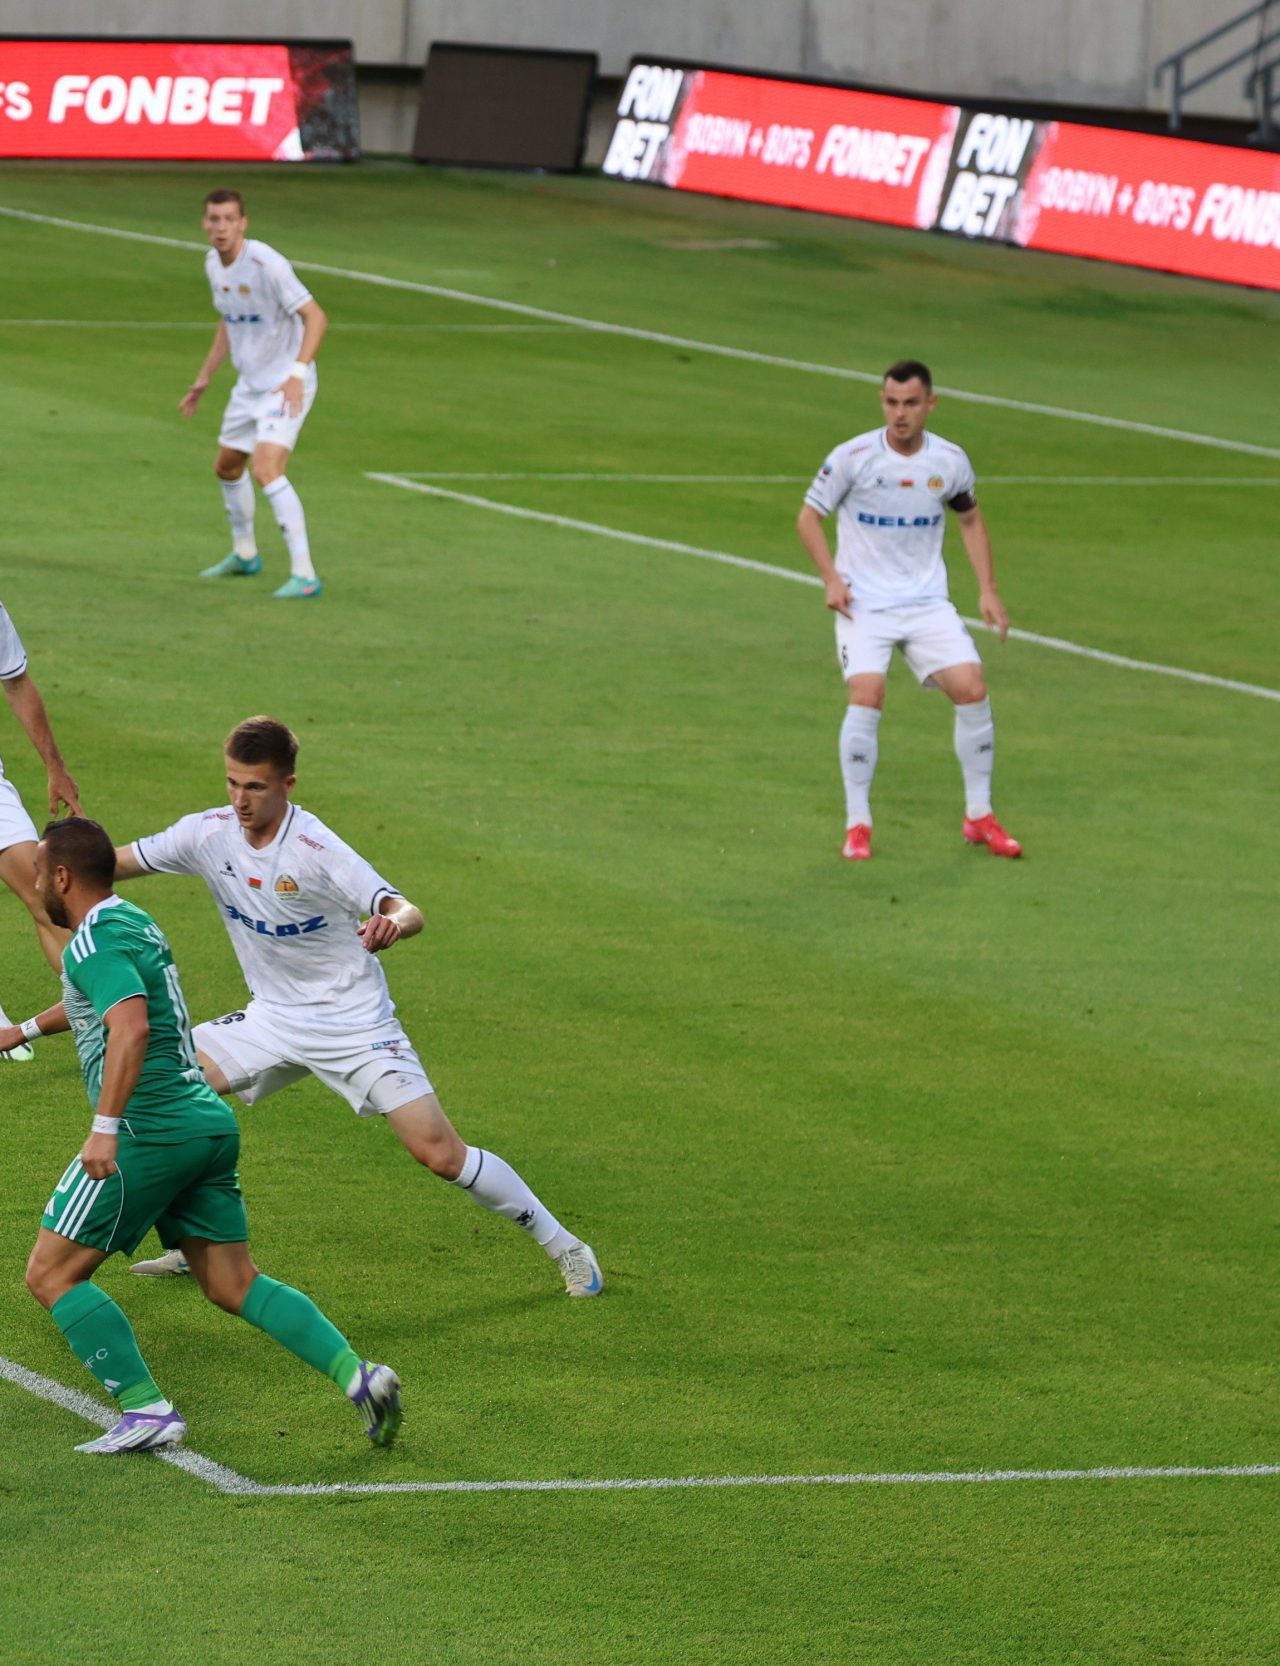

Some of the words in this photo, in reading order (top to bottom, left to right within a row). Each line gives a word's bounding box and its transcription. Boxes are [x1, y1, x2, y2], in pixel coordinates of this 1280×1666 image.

[48, 74, 284, 125] FONBET
[617, 65, 684, 122] FON
[602, 119, 670, 180] BET
[761, 123, 815, 170] 80FS
[815, 124, 930, 187] FONBET
[957, 112, 1034, 176] FON
[940, 171, 1019, 238] BET
[1131, 180, 1196, 232] 80FS
[1192, 182, 1280, 250] FONB
[858, 512, 942, 527] BELAZ
